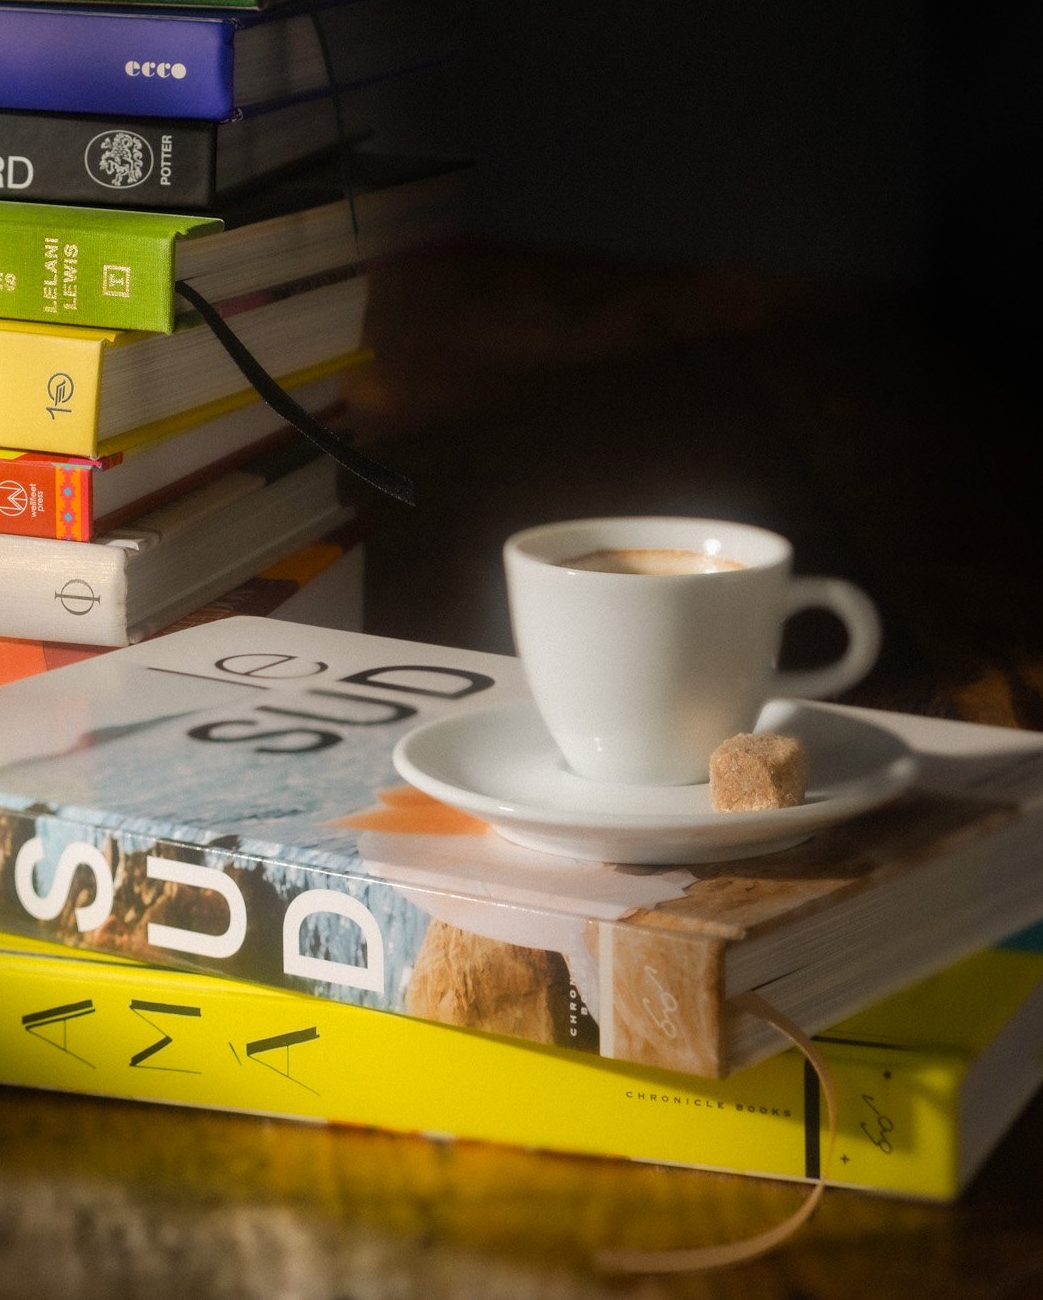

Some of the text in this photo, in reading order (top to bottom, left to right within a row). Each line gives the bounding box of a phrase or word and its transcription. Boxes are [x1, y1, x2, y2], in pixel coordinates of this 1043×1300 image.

[124, 60, 187, 80] ecco
[159, 134, 173, 186] POTTER
[43, 237, 59, 314] LELANI
[62, 244, 79, 311] LEWIS
[37, 490, 45, 512] press
[626, 1090, 792, 1117] CHRONICLE BOOKS
